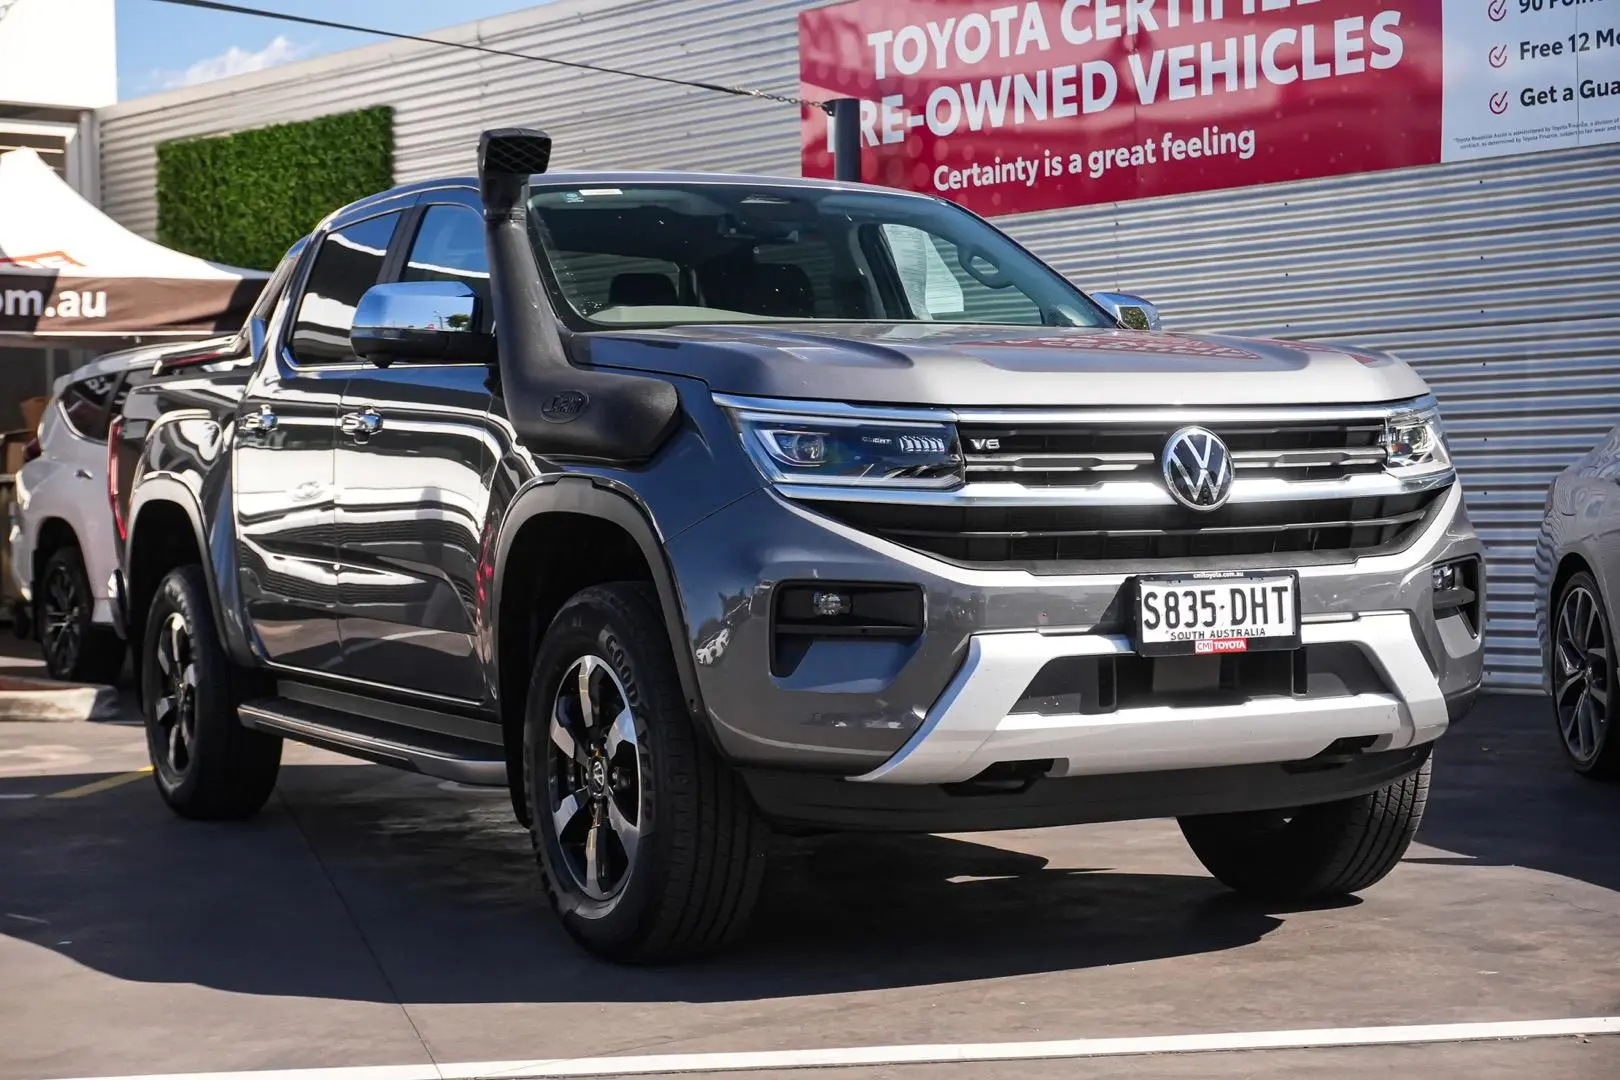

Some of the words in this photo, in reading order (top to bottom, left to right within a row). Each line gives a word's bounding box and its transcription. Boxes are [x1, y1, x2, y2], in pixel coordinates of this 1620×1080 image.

[867, 1, 1051, 80] TOYOTA
[1520, 41, 1563, 60] Free
[1568, 32, 1590, 52] 12
[827, 61, 1118, 153] RE-OWNED
[1128, 11, 1403, 105] VEHICLES
[1520, 86, 1557, 107] Get
[1562, 87, 1574, 101] a
[933, 153, 1040, 191] Certainty
[1044, 148, 1064, 176] is
[1068, 154, 1083, 173] a
[1088, 140, 1156, 178] great
[1162, 125, 1256, 159] feeling
[970, 439, 1000, 449] V6
[1170, 631, 1205, 640] SOUTH
[1209, 628, 1266, 638] AUSTRALIA
[1214, 641, 1246, 650] TOYOTA
